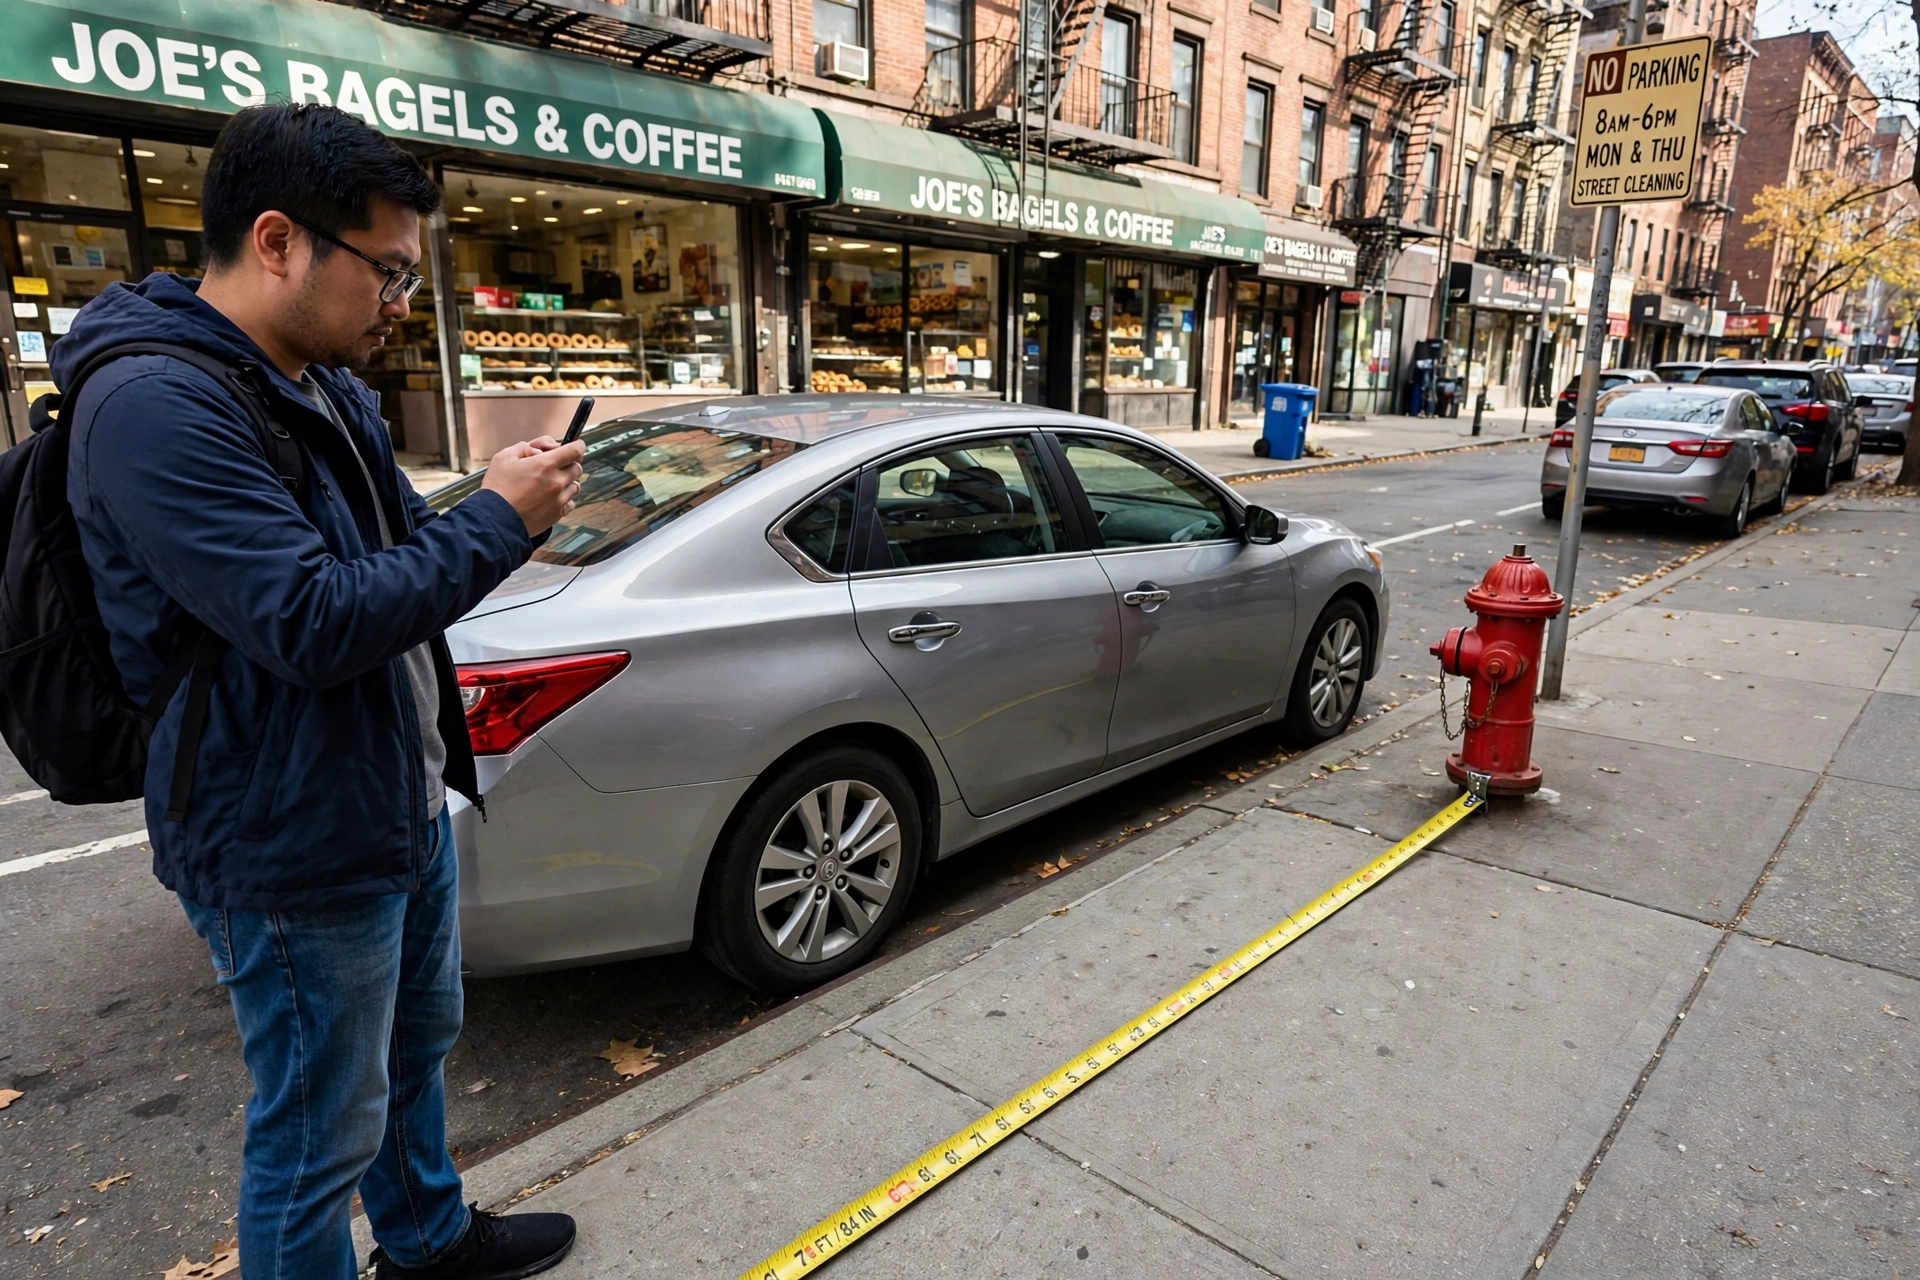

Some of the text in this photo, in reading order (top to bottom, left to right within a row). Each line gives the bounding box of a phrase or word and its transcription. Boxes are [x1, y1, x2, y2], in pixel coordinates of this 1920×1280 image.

[1588, 53, 1701, 93] NO PARKING
[51, 22, 743, 178] JOE'S BAGELS & COFFEE
[1595, 103, 1677, 135] 8AM-6PM
[1586, 136, 1686, 168] MON & THU
[1577, 171, 1685, 197] STREET CLEANING
[910, 175, 1174, 246] JOE'S BAGELS & COFFEE
[814, 1234, 834, 1254] FT
[839, 1216, 860, 1238] 84
[858, 1205, 877, 1223] IN
